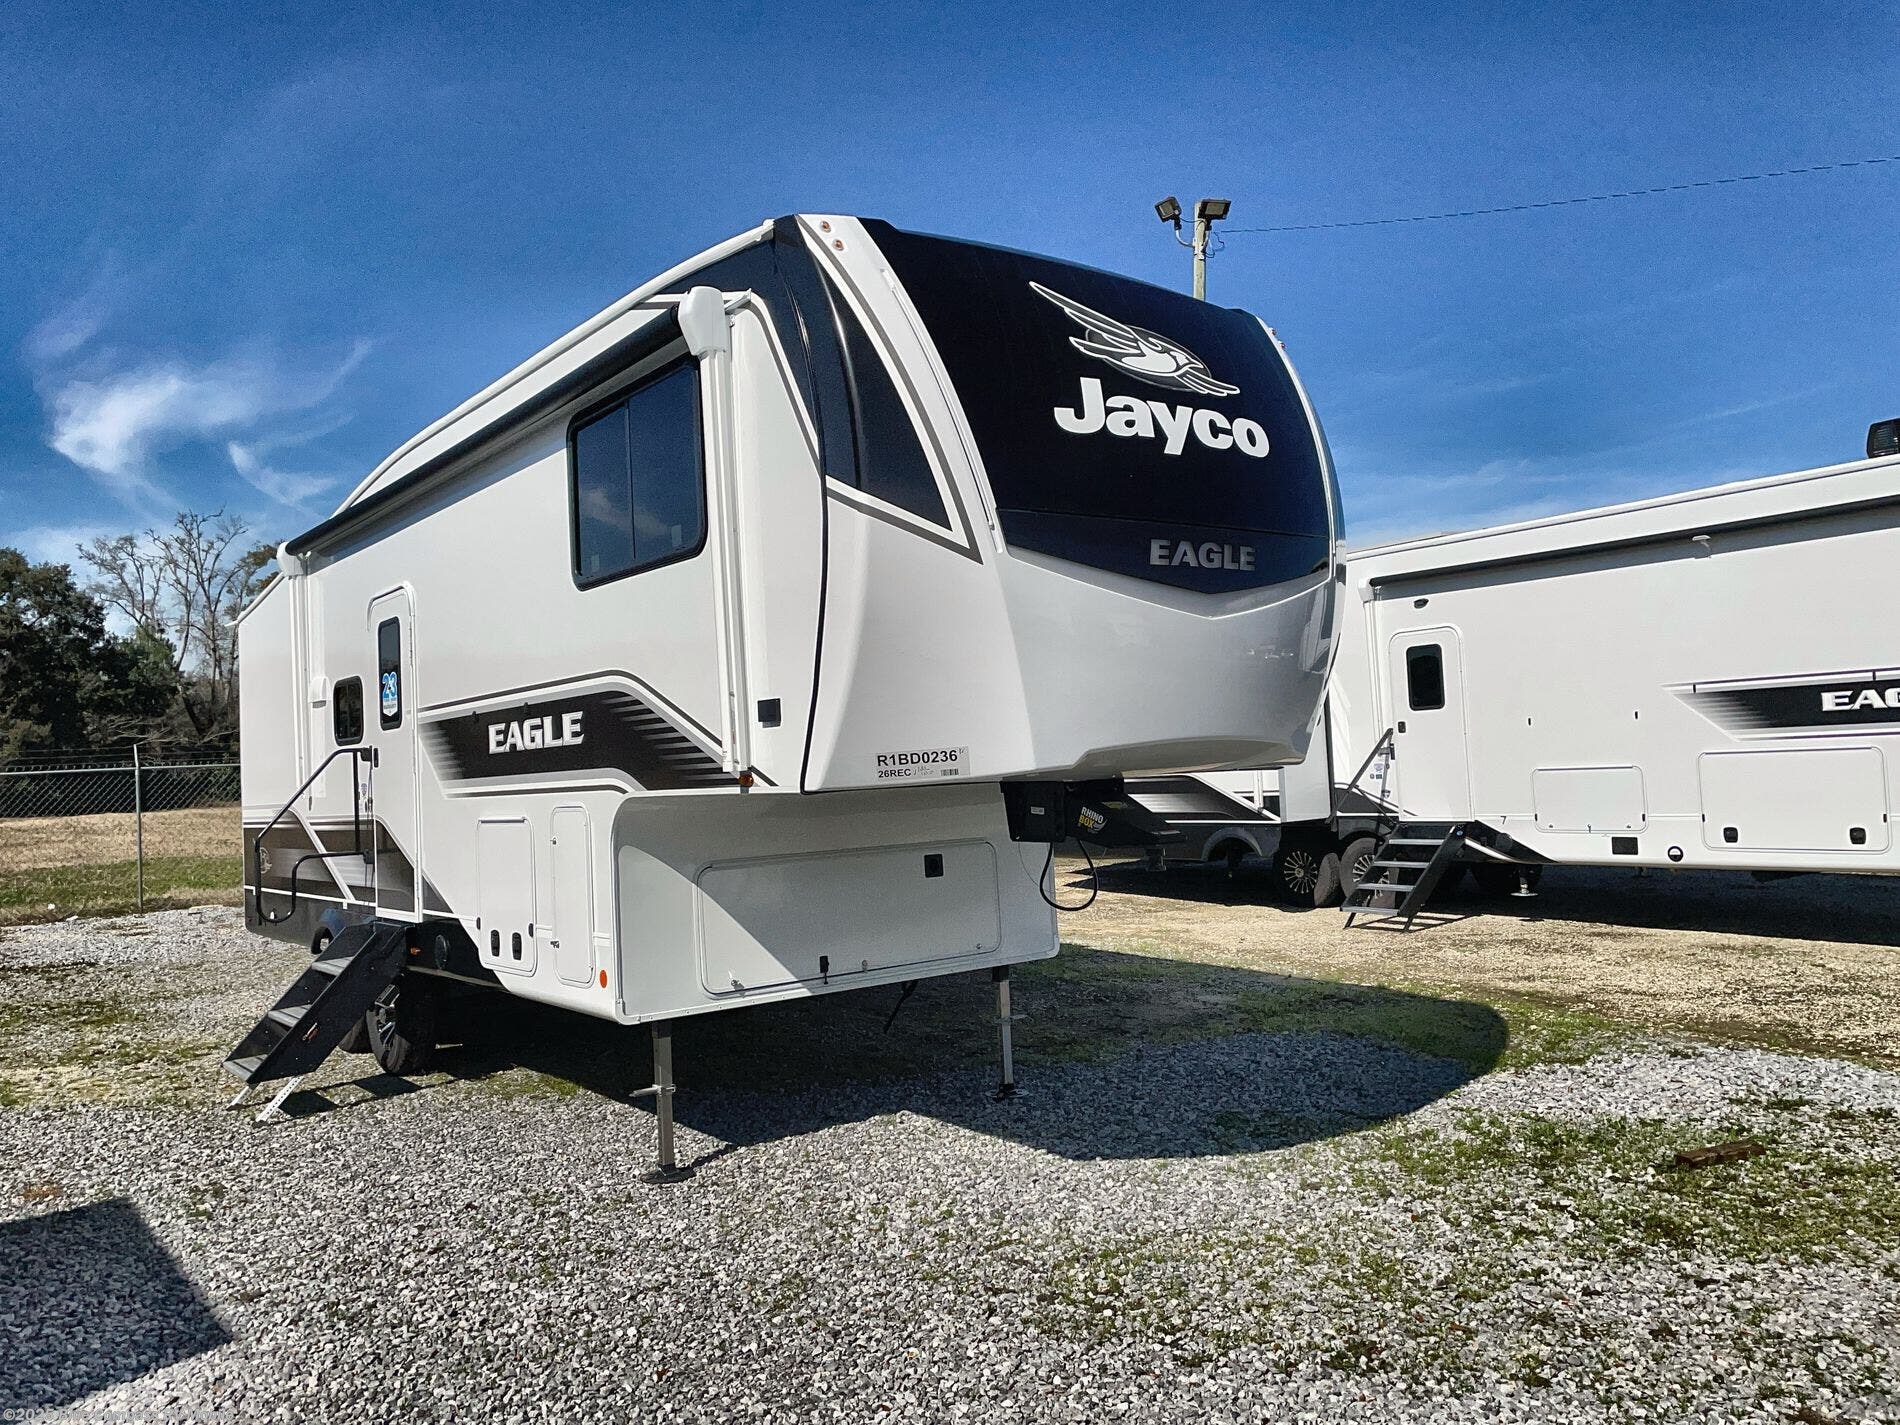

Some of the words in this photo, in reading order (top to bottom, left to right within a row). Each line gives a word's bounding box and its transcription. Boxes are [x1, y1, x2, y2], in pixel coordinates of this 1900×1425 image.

[1053, 376, 1270, 458] Jayco
[1149, 539, 1256, 571] EAGLE
[488, 711, 585, 755] EAGLE
[877, 749, 958, 767] R1BD0236
[878, 768, 912, 778] 26REC
[1079, 814, 1095, 829] BOX
[1081, 806, 1104, 824] RHINO
